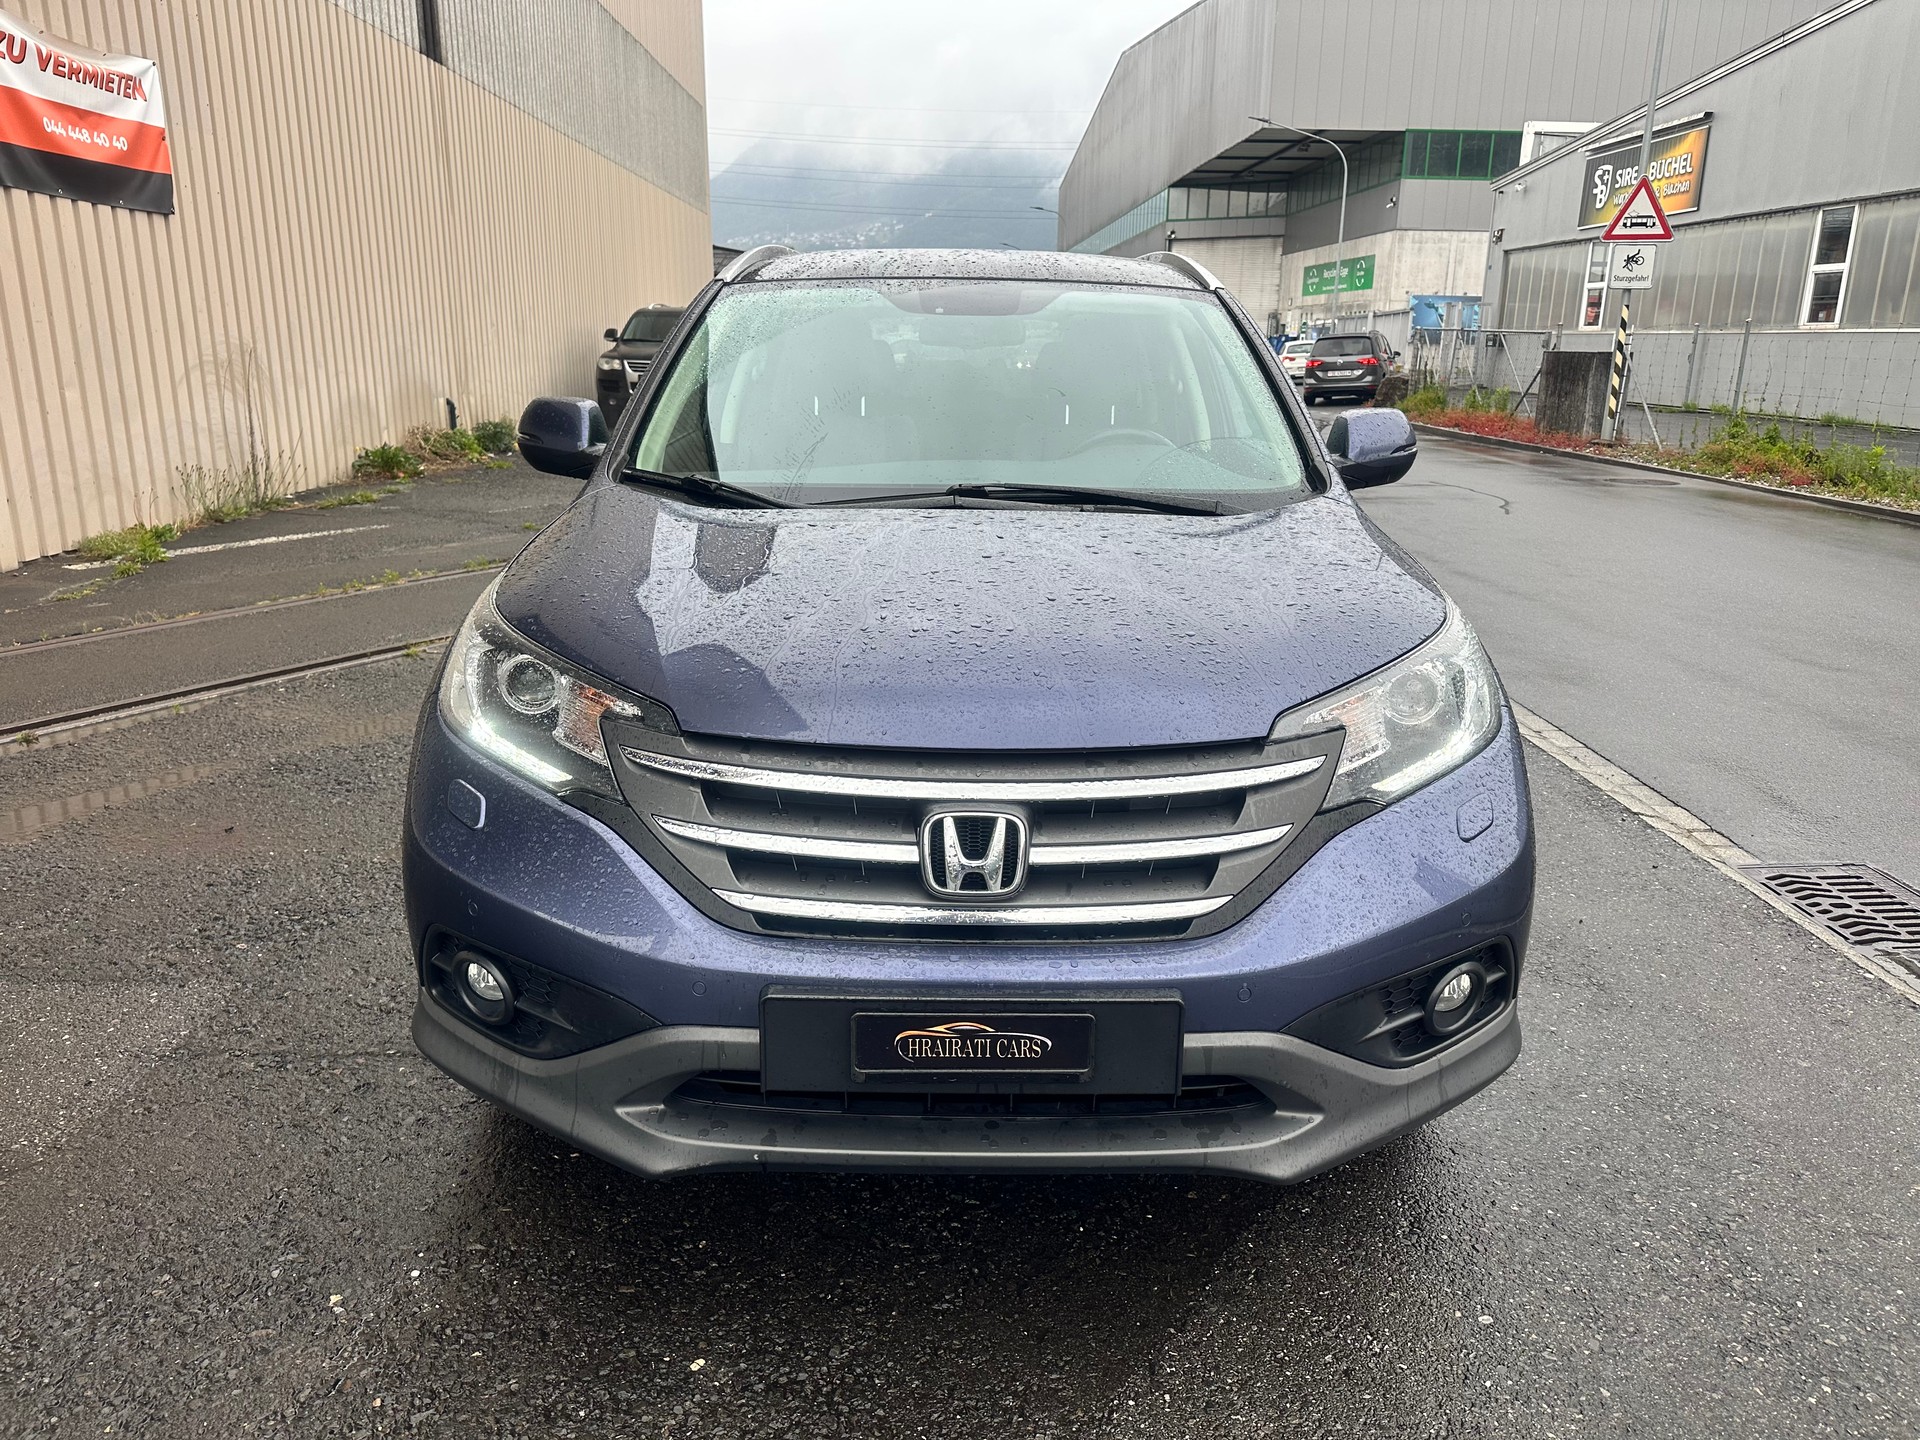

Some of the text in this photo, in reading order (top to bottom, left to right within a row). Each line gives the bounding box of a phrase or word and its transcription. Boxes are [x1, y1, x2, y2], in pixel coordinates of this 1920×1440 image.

[35, 43, 148, 102] VERMIETEN
[43, 117, 128, 151] 044 448 40 40
[907, 1038, 1042, 1059] HRAIRATI CARS
